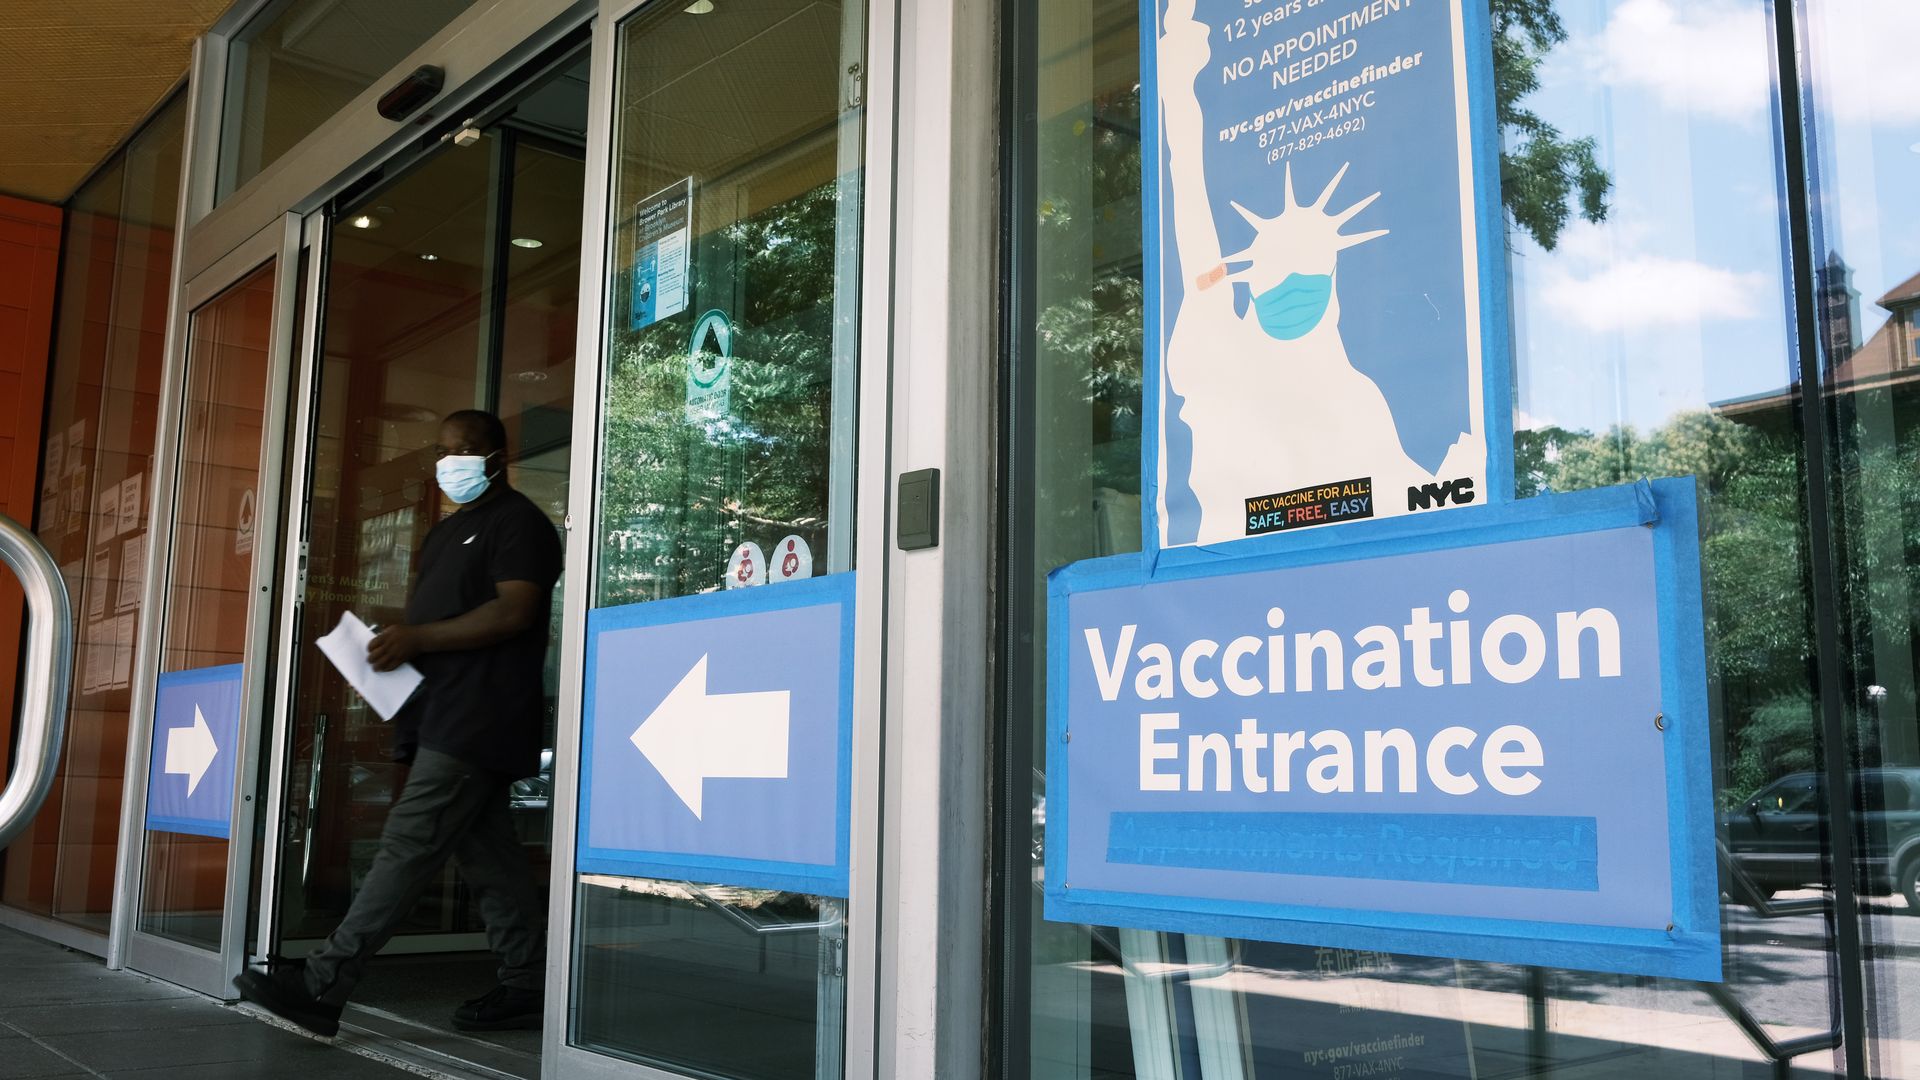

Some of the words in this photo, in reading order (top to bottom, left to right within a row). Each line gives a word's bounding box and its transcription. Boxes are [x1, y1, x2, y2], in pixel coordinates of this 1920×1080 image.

[1223, 18, 1246, 42] 12
[1251, 1, 1302, 37] years
[1223, 57, 1255, 85] NO
[1272, 38, 1358, 90] NEEDED
[1219, 51, 1423, 142] nyc.gov/vaccinefinder
[1258, 90, 1376, 149] 877-VAX-4NYC
[1266, 116, 1366, 165] (877-829-4692)
[639, 203, 662, 217] Welcome
[661, 199, 668, 208] to
[657, 206, 668, 218] Park
[669, 198, 687, 212] Library
[1248, 499, 1270, 513] NYC
[1271, 491, 1315, 509] VACCINE
[1317, 486, 1340, 500] FOR
[1342, 483, 1370, 496] ALL:
[1407, 477, 1475, 512] NYC
[1249, 511, 1285, 530] SAFE,
[1287, 505, 1327, 524] FREE,
[1330, 497, 1369, 517] EASY
[320, 590, 358, 603] Honor
[360, 594, 384, 606] Roll
[1083, 589, 1622, 702] Vaccination
[1139, 711, 1545, 796] Entrance
[1120, 816, 1366, 866] Appointments
[1378, 822, 1585, 878] Required
[1303, 1032, 1426, 1065] nyc.gov/vaccinefinder
[1333, 1056, 1405, 1080] 877-VAX-4NYC
